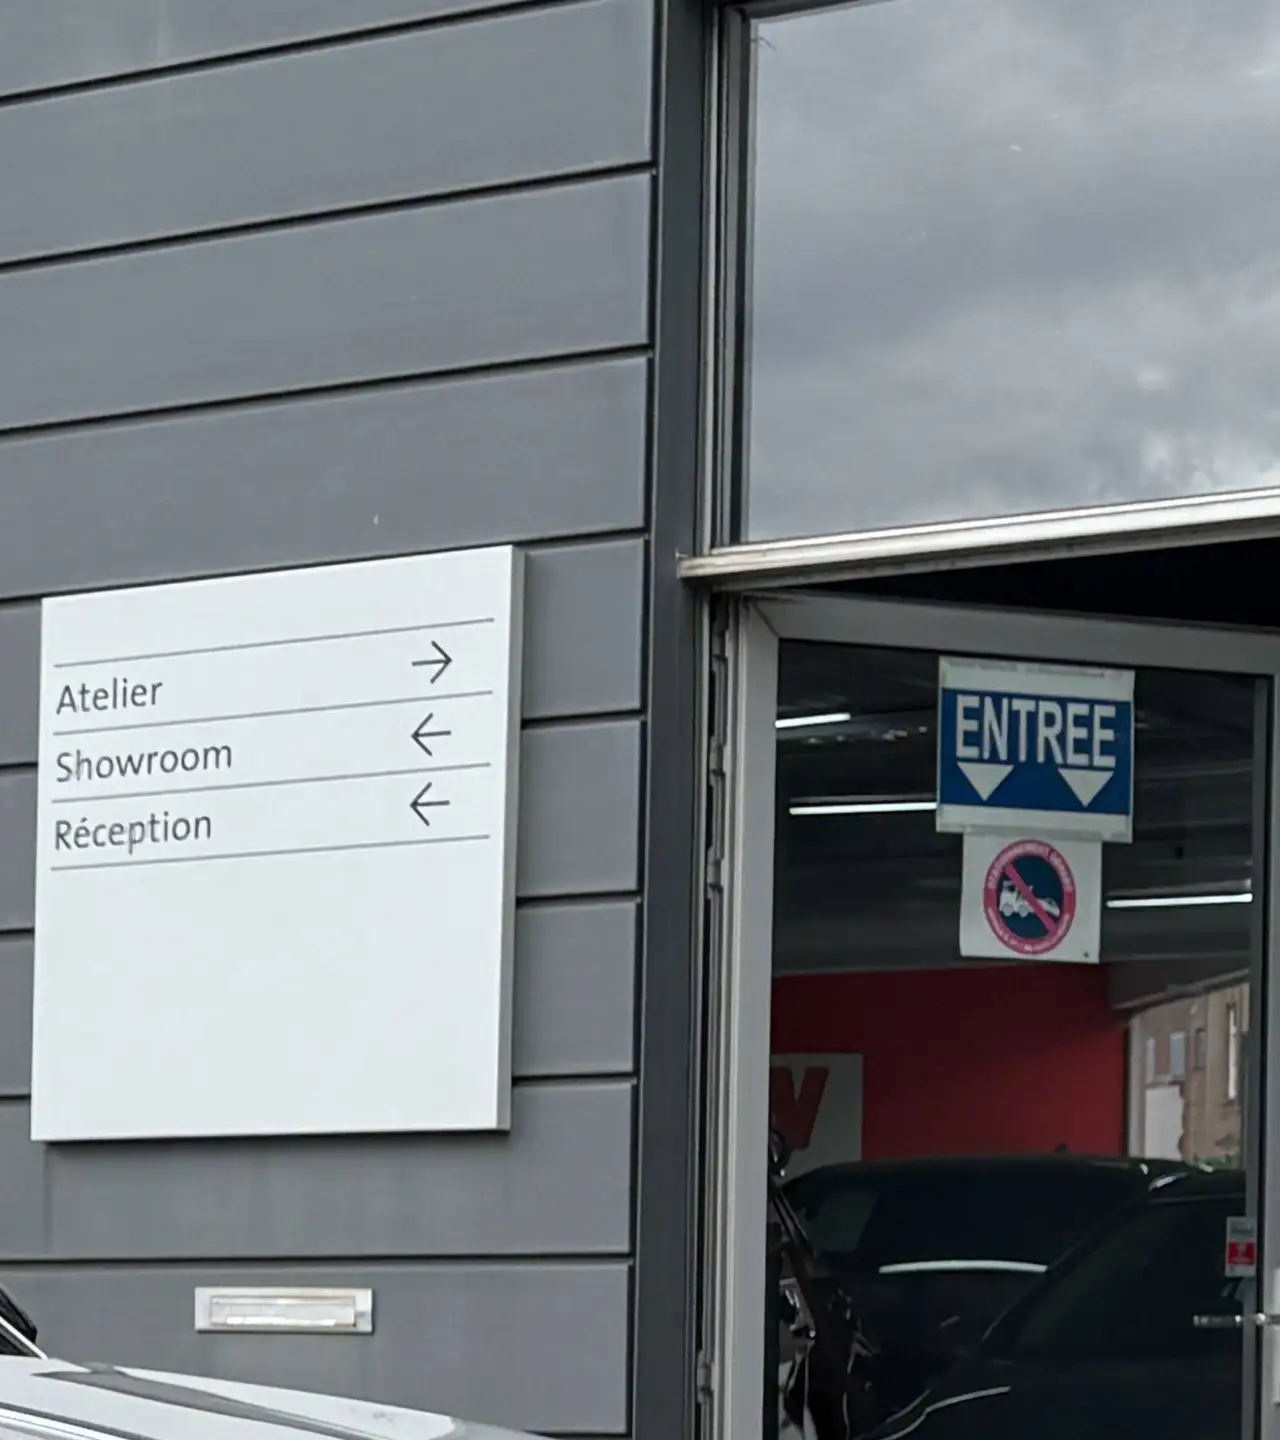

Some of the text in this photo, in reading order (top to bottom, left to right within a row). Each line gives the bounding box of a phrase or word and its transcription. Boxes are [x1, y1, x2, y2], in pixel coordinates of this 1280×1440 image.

[55, 677, 164, 715] Atelier
[955, 694, 1117, 768] ENTREE
[55, 740, 233, 783] Showroom
[54, 810, 213, 855] Réception
